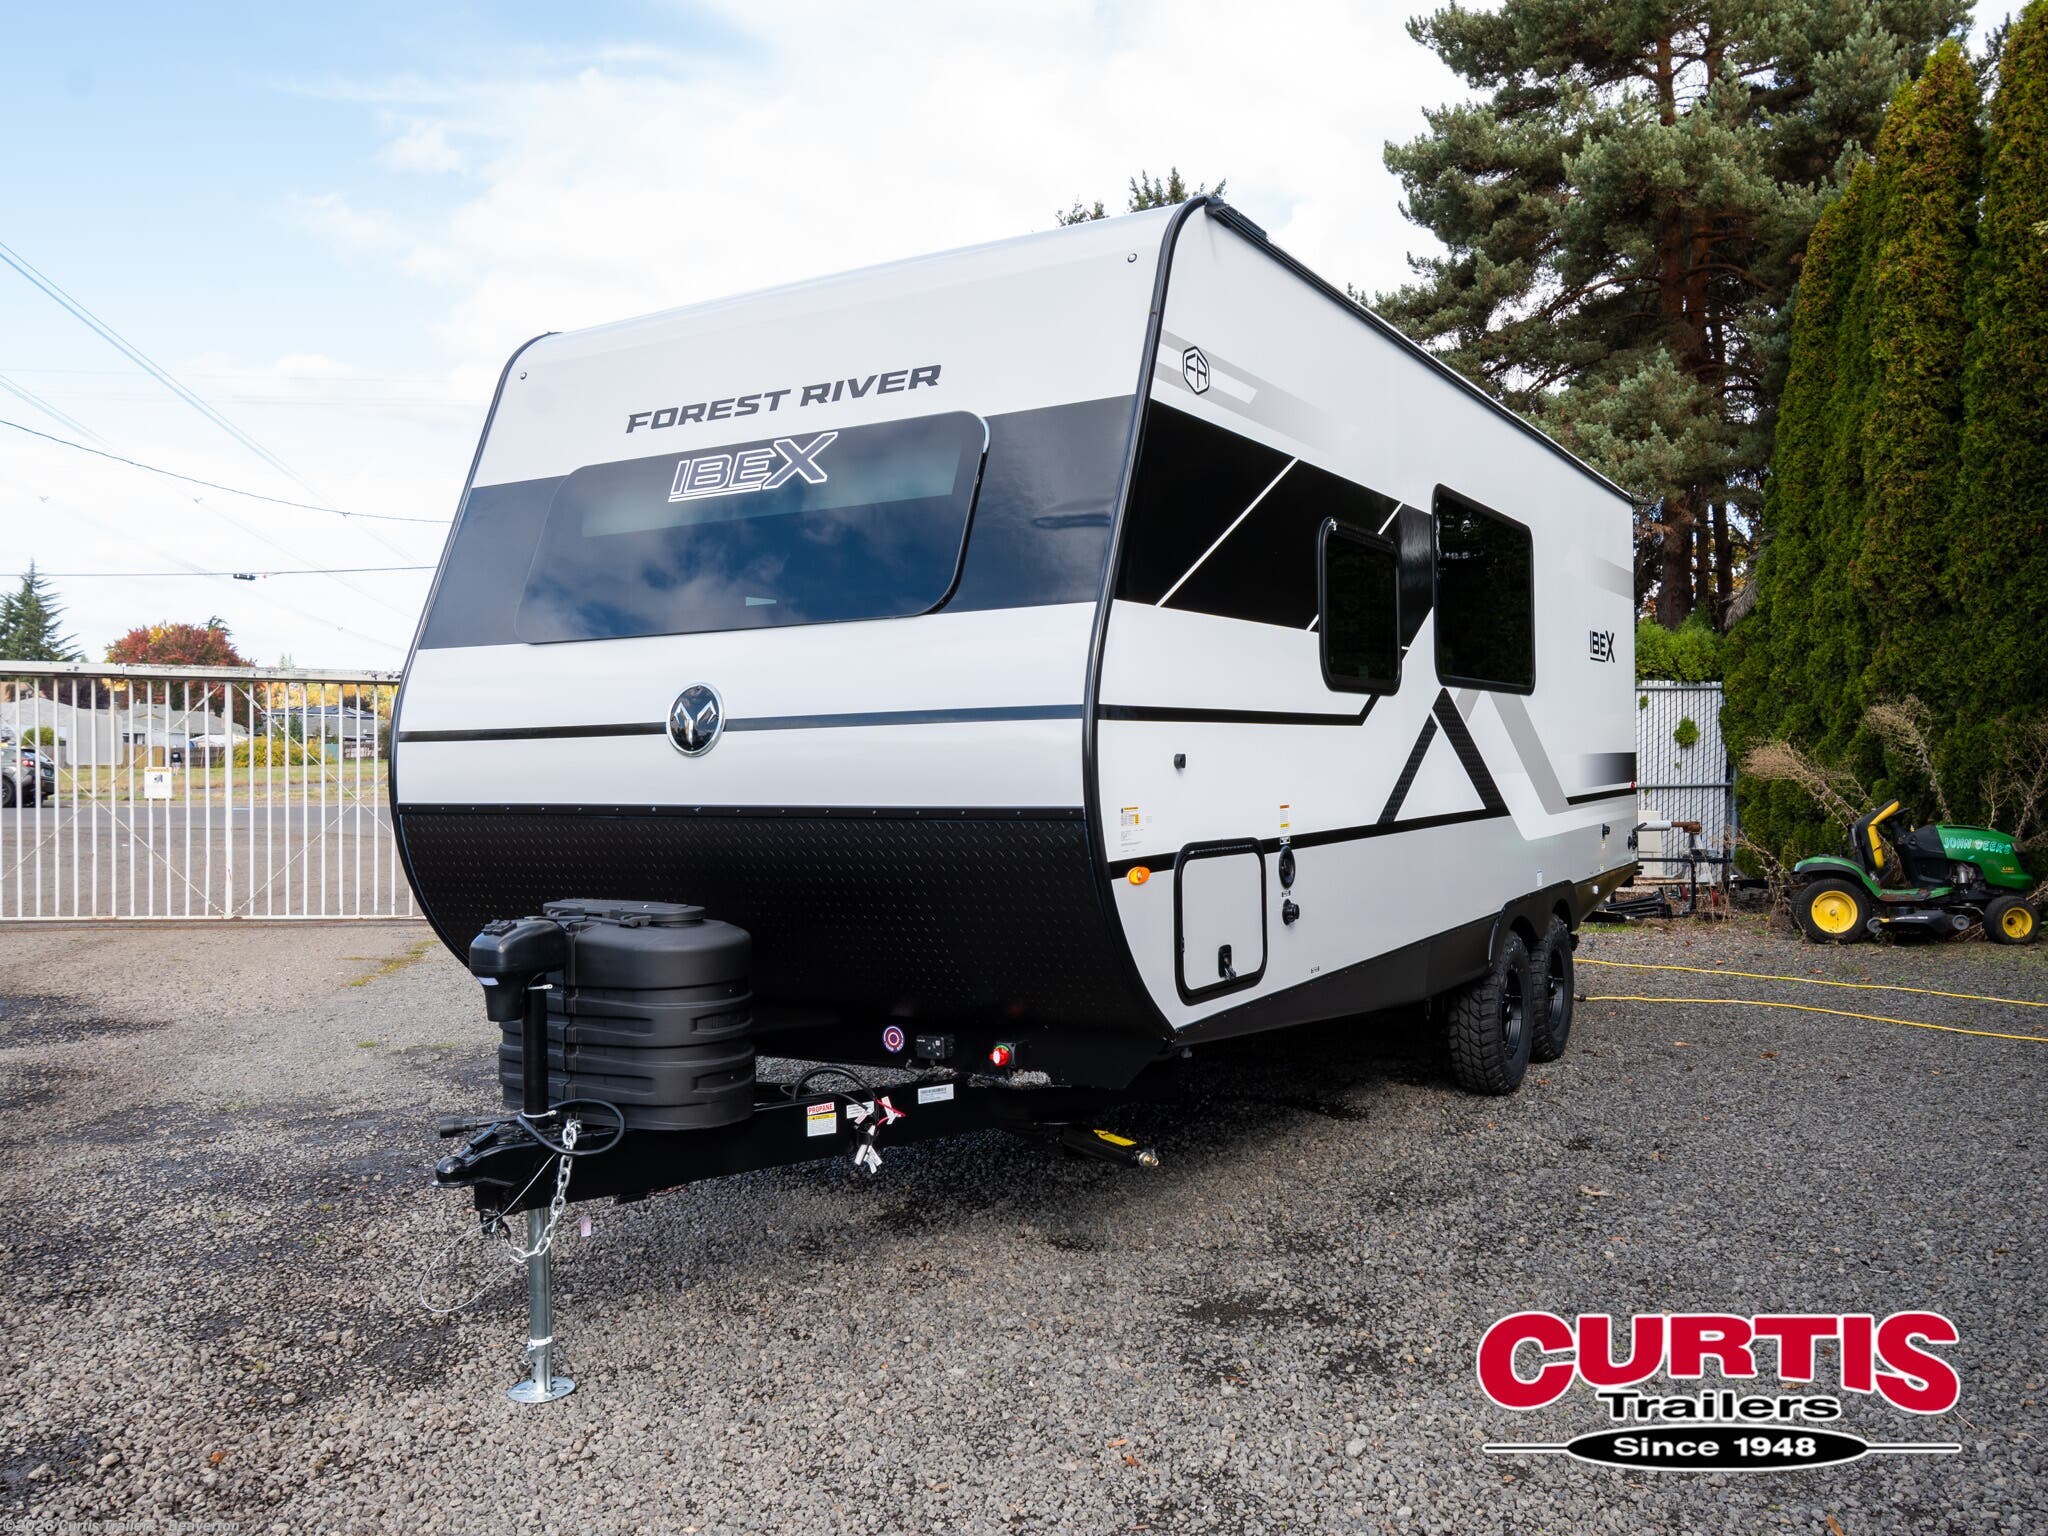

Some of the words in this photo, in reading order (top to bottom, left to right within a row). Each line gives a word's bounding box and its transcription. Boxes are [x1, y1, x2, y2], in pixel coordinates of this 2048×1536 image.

[625, 389, 791, 434] FOREST
[800, 364, 941, 407] RIVER
[667, 431, 839, 502] IBEX
[1589, 629, 1616, 663] IBEX
[808, 1103, 834, 1114] PROPANE
